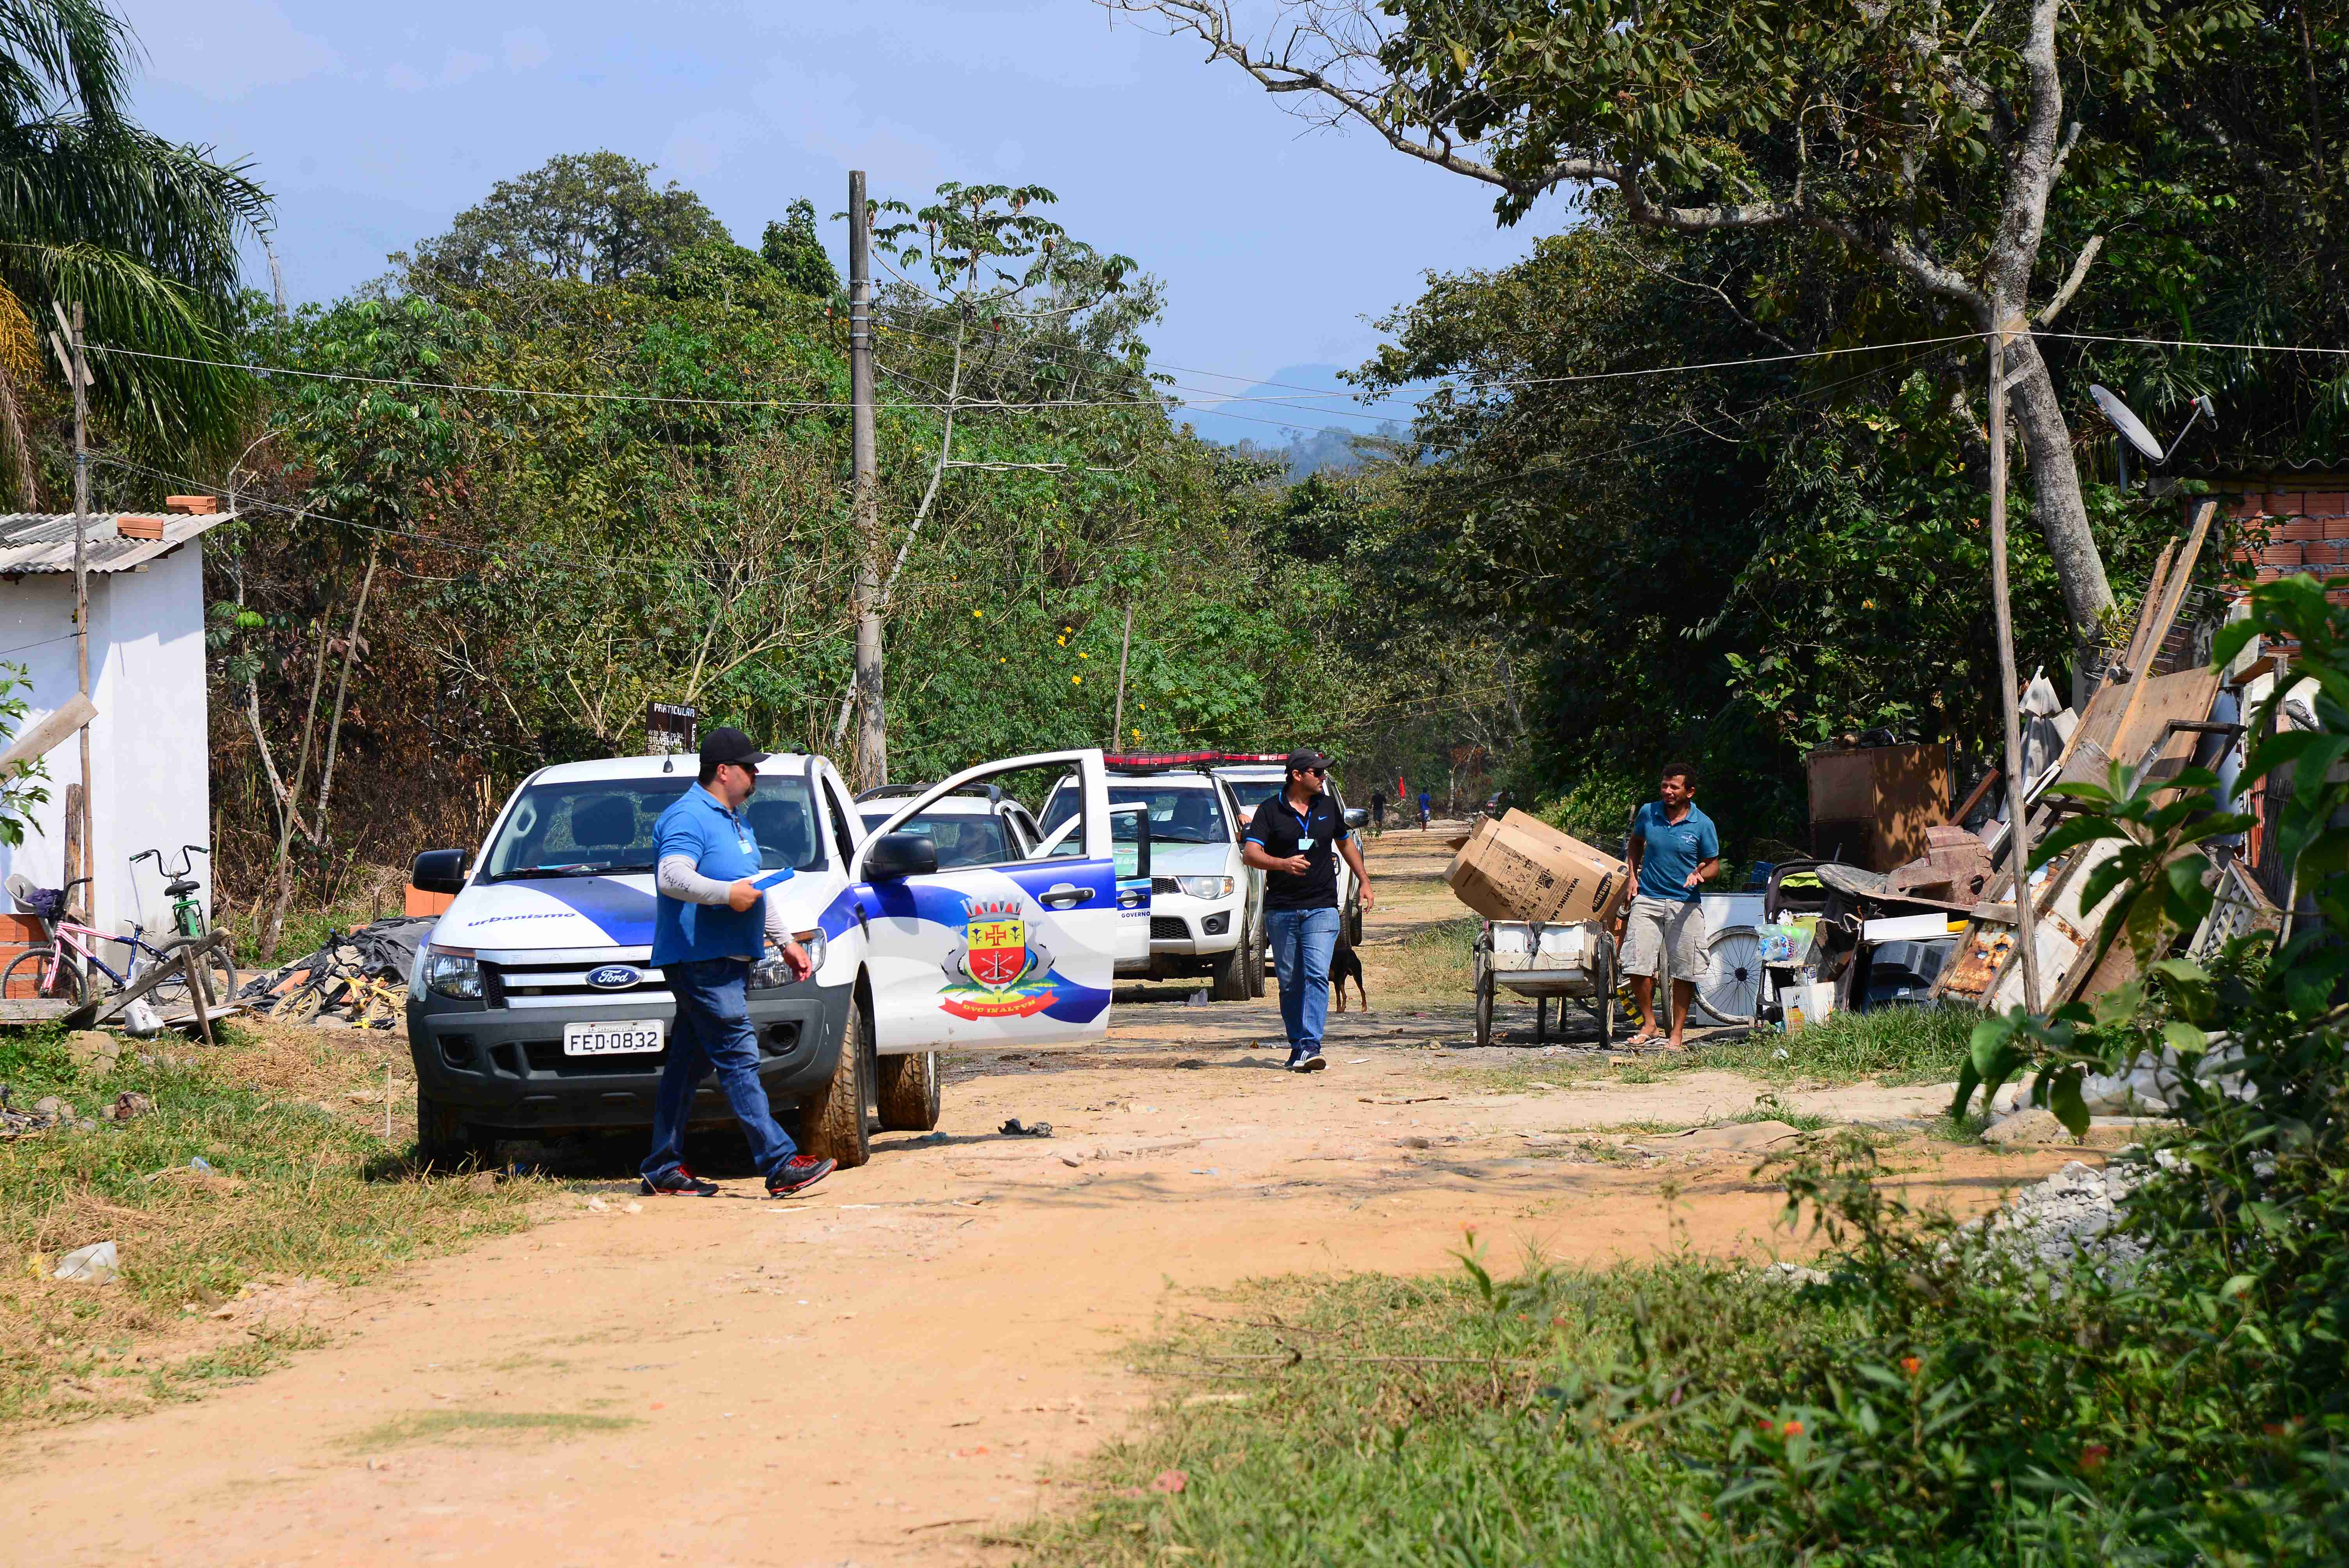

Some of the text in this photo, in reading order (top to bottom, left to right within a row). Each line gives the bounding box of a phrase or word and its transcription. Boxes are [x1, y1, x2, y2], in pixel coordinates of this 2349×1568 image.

[654, 703, 695, 718] PARTICULAR
[1556, 877, 1580, 909] WASHING
[468, 913, 575, 927] urbanismo
[598, 970, 629, 983] Ford
[1000, 999, 1036, 1012] ALTVM
